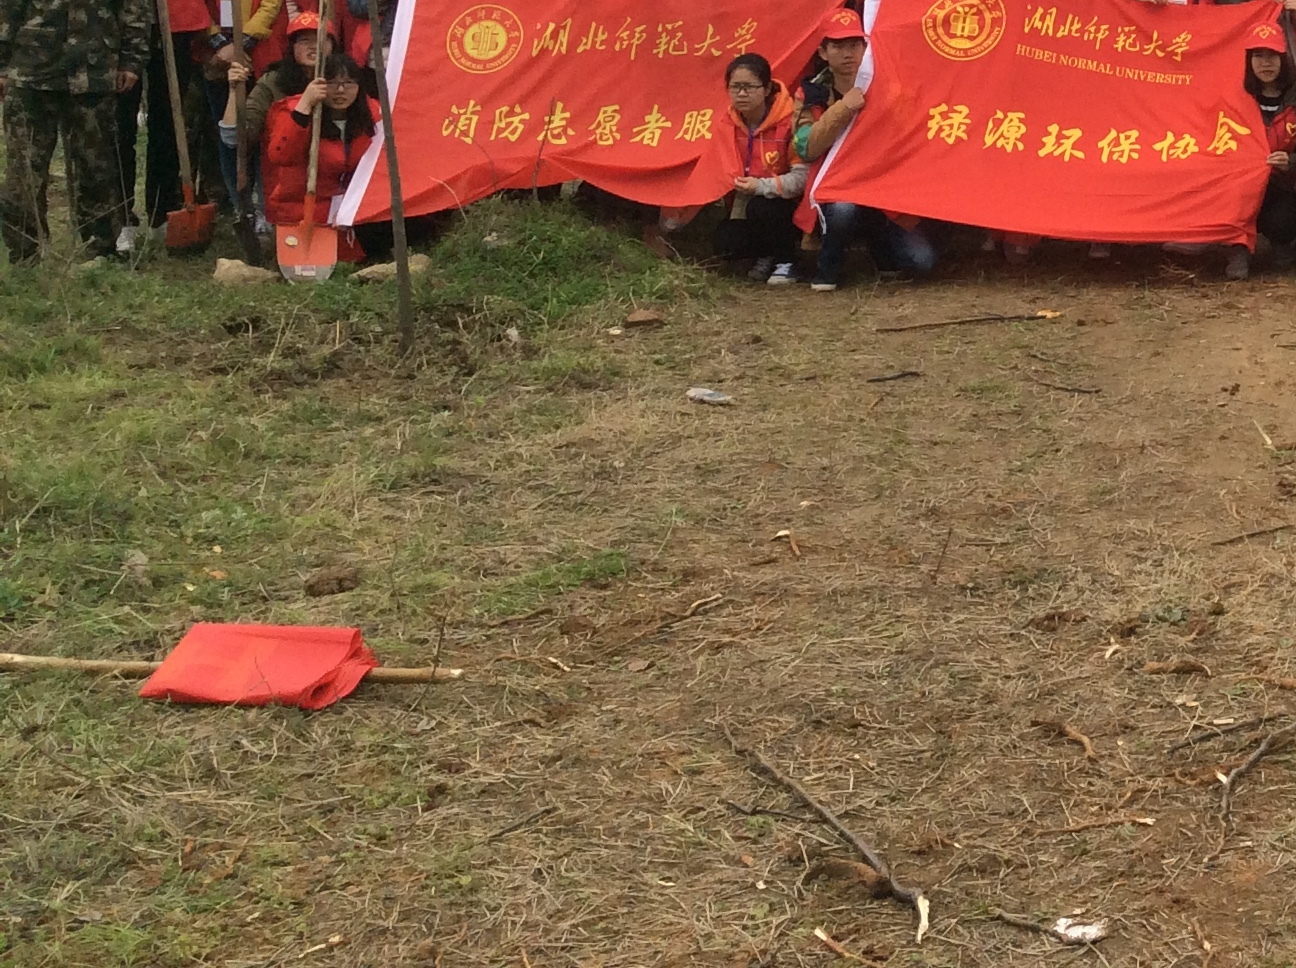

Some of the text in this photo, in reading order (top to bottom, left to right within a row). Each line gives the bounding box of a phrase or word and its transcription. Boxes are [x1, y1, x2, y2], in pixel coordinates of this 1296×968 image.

[1015, 43, 1193, 85] HUBEI NORMAL UNIVERSITY
[441, 98, 714, 148] 消防志愿者服
[927, 102, 1252, 164] 绿源环保协会
